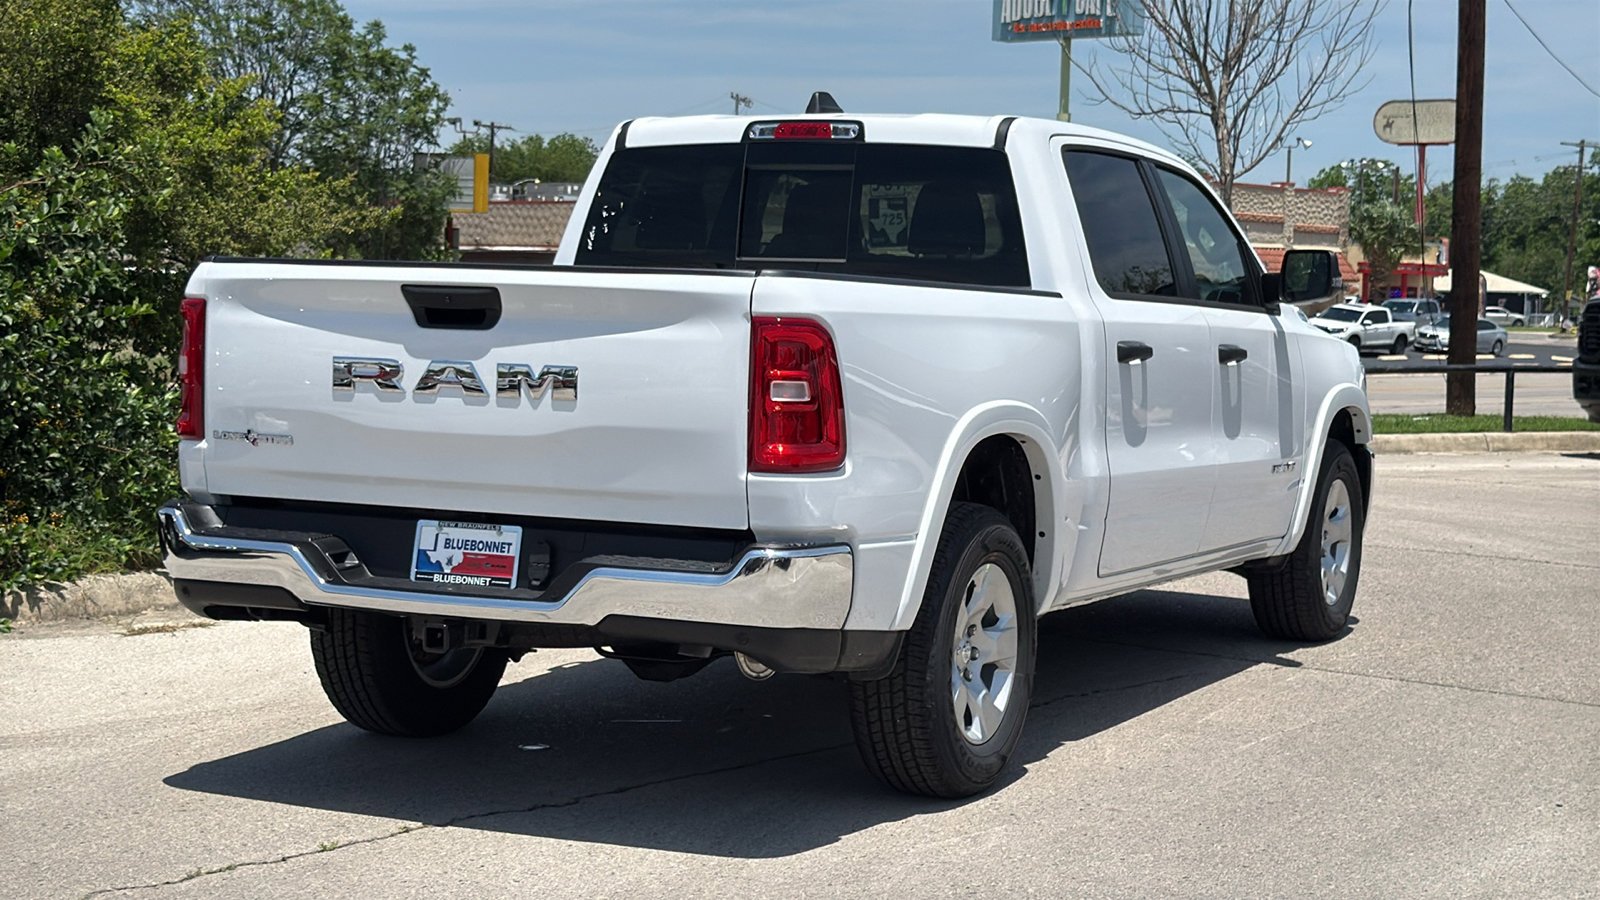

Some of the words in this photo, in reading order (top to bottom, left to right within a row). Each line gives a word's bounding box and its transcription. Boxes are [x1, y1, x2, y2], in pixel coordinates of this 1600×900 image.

[882, 213, 903, 226] 725
[332, 356, 579, 401] RAM
[444, 538, 513, 554] BLUEBONNET
[433, 574, 492, 586] BLUEBONNET
